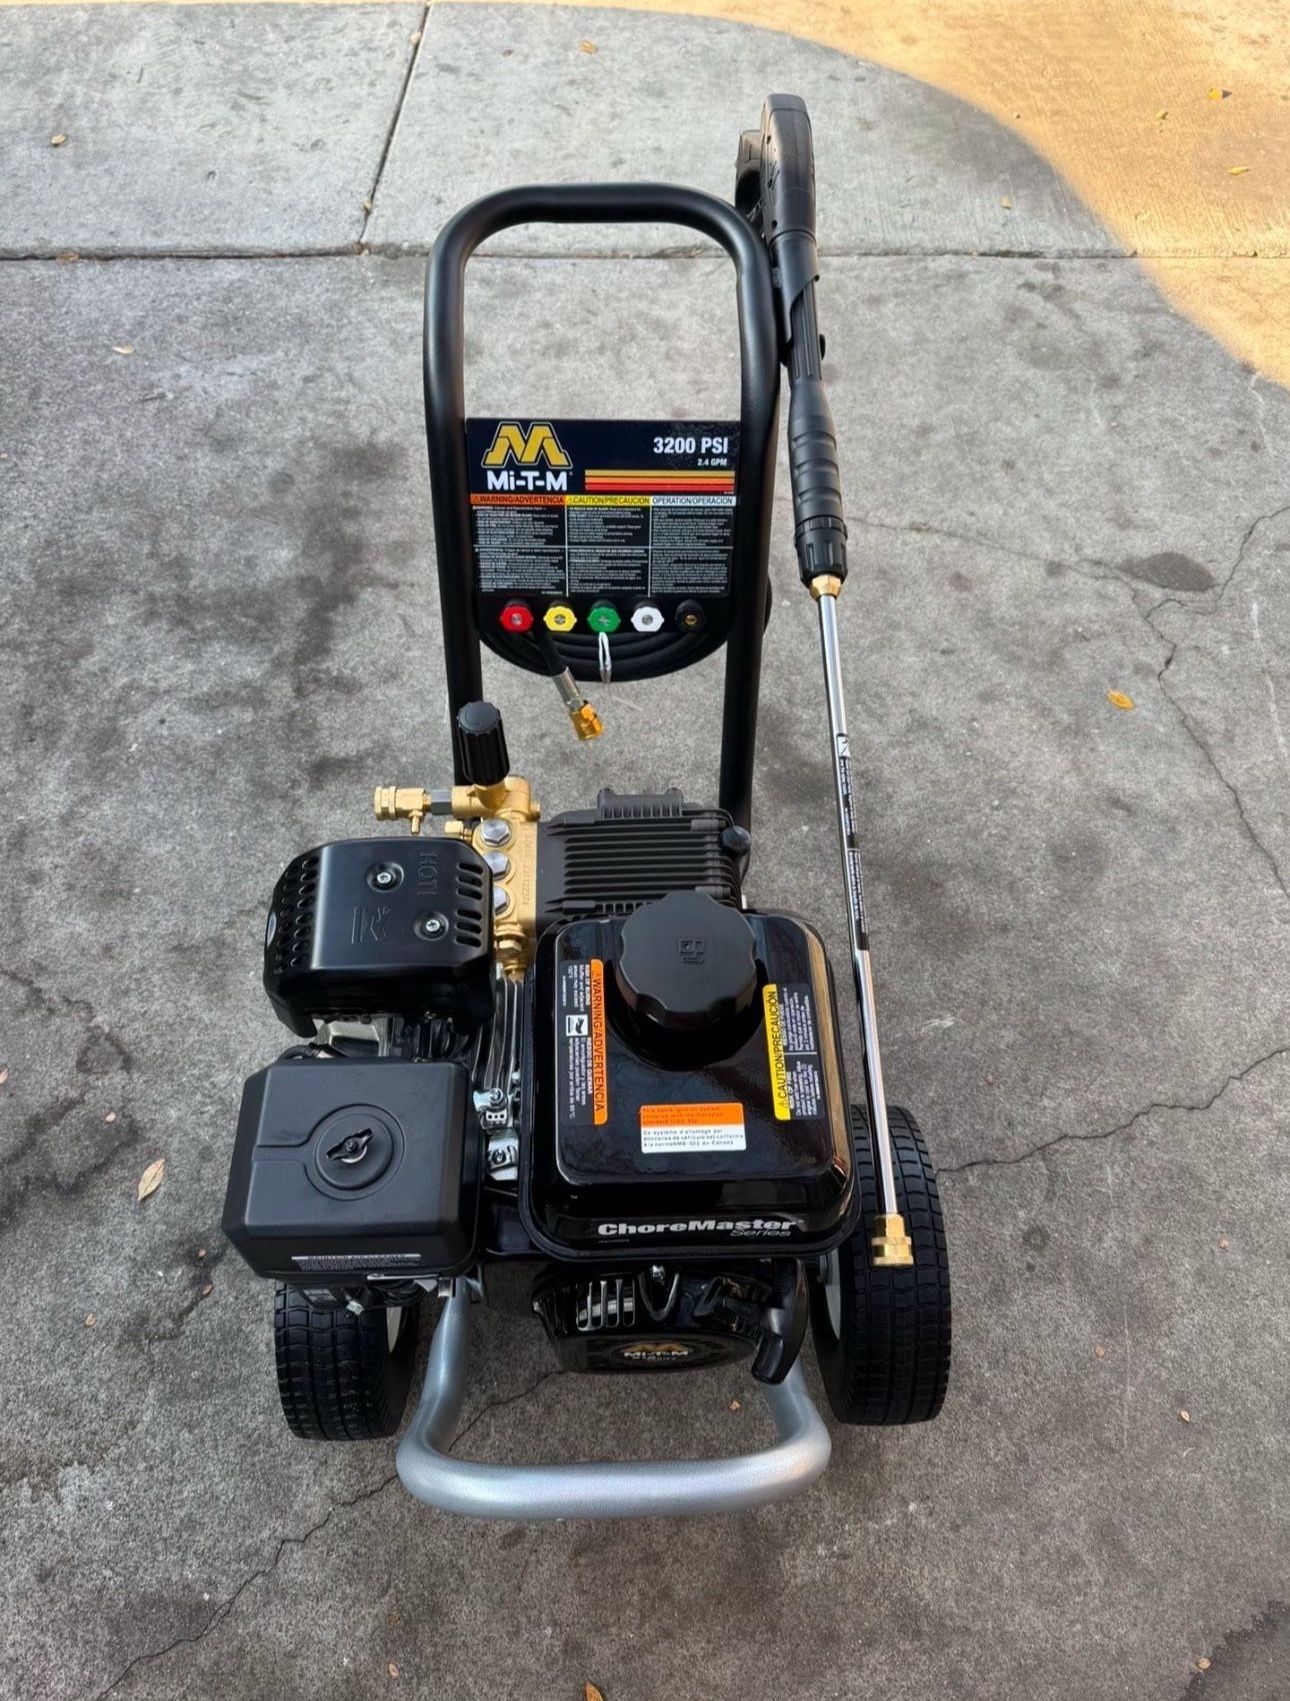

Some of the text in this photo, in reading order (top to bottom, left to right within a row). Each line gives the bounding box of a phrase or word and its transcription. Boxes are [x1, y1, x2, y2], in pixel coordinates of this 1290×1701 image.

[653, 436, 729, 454] 3200 PSI
[697, 458, 728, 467] 2.4 GPM
[486, 470, 568, 491] Mi-T-M
[592, 978, 605, 1112] WARNING/ADVERTENCIA
[598, 1219, 797, 1236] ChoreMaster
[730, 1228, 792, 1238] Series
